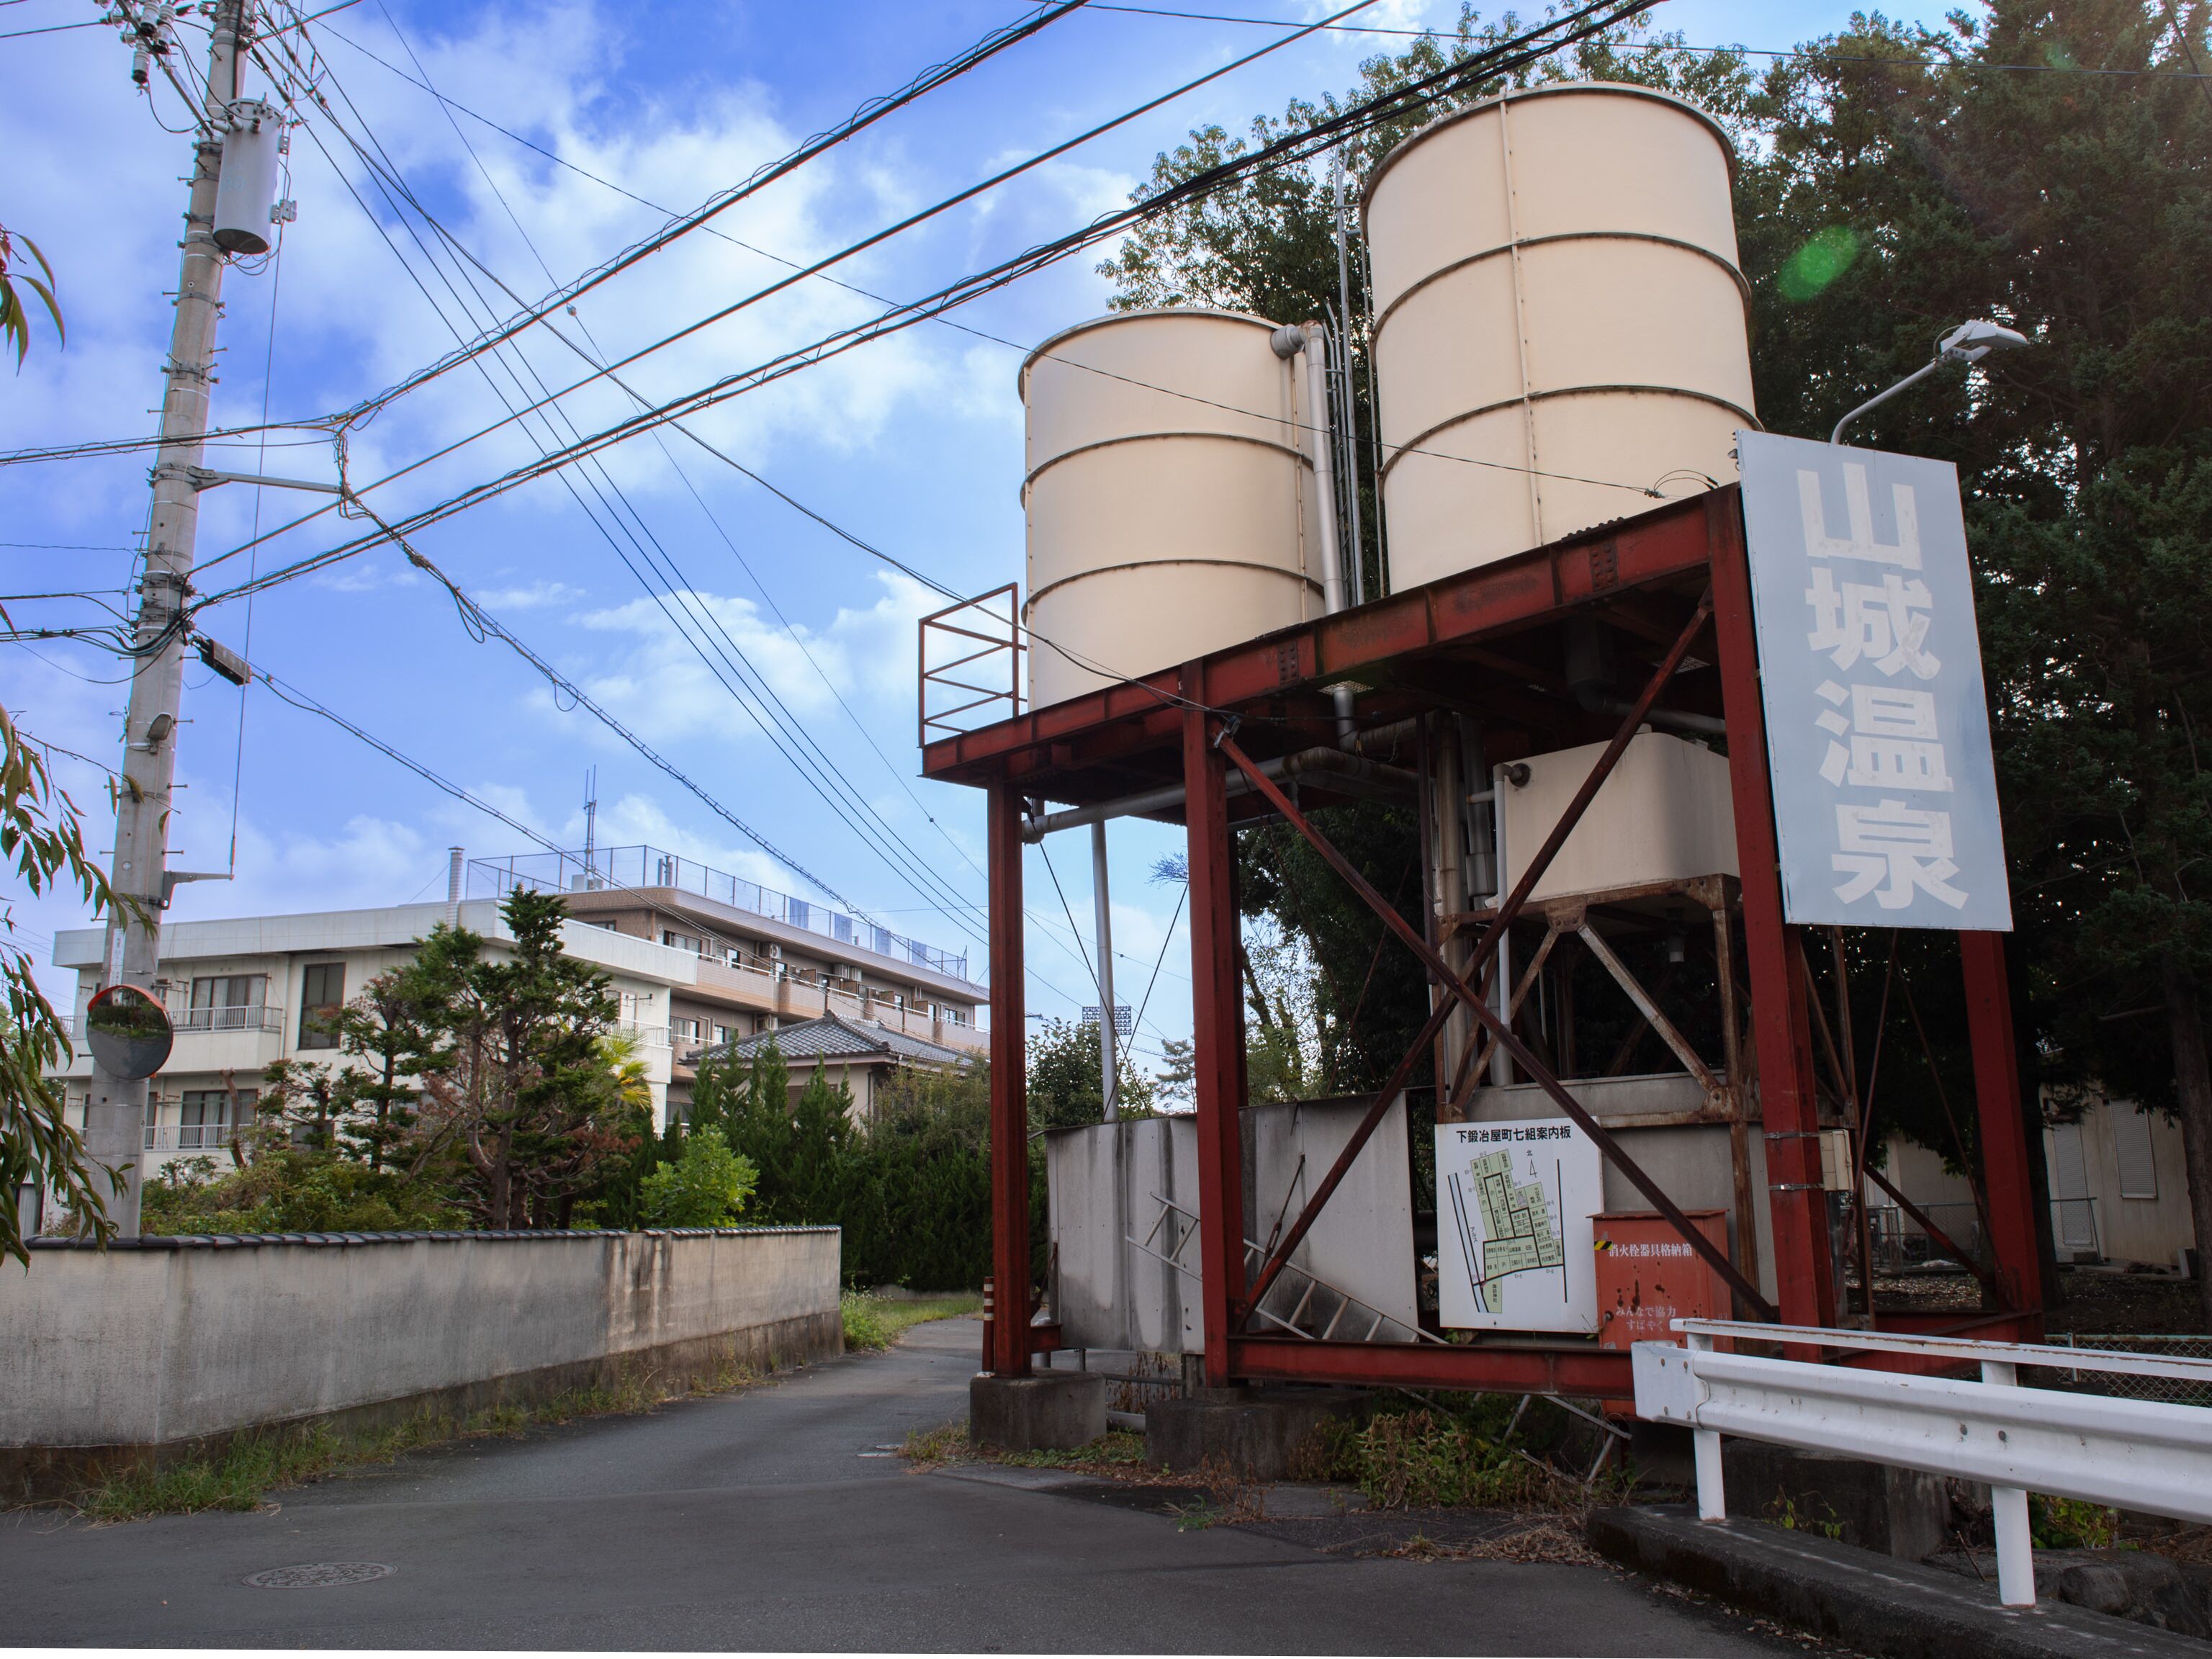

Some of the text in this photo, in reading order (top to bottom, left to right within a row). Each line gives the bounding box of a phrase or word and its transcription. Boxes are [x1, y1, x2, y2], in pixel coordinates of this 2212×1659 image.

[1797, 461, 1969, 911] 山城温泉
[1456, 1125, 1571, 1143] 下鍛冶屋町七組案内板
[1609, 1244, 1692, 1257] 消火栓器具格納箱
[1616, 1306, 1676, 1318] みんなで協力
[1627, 1319, 1664, 1331] すばやく
